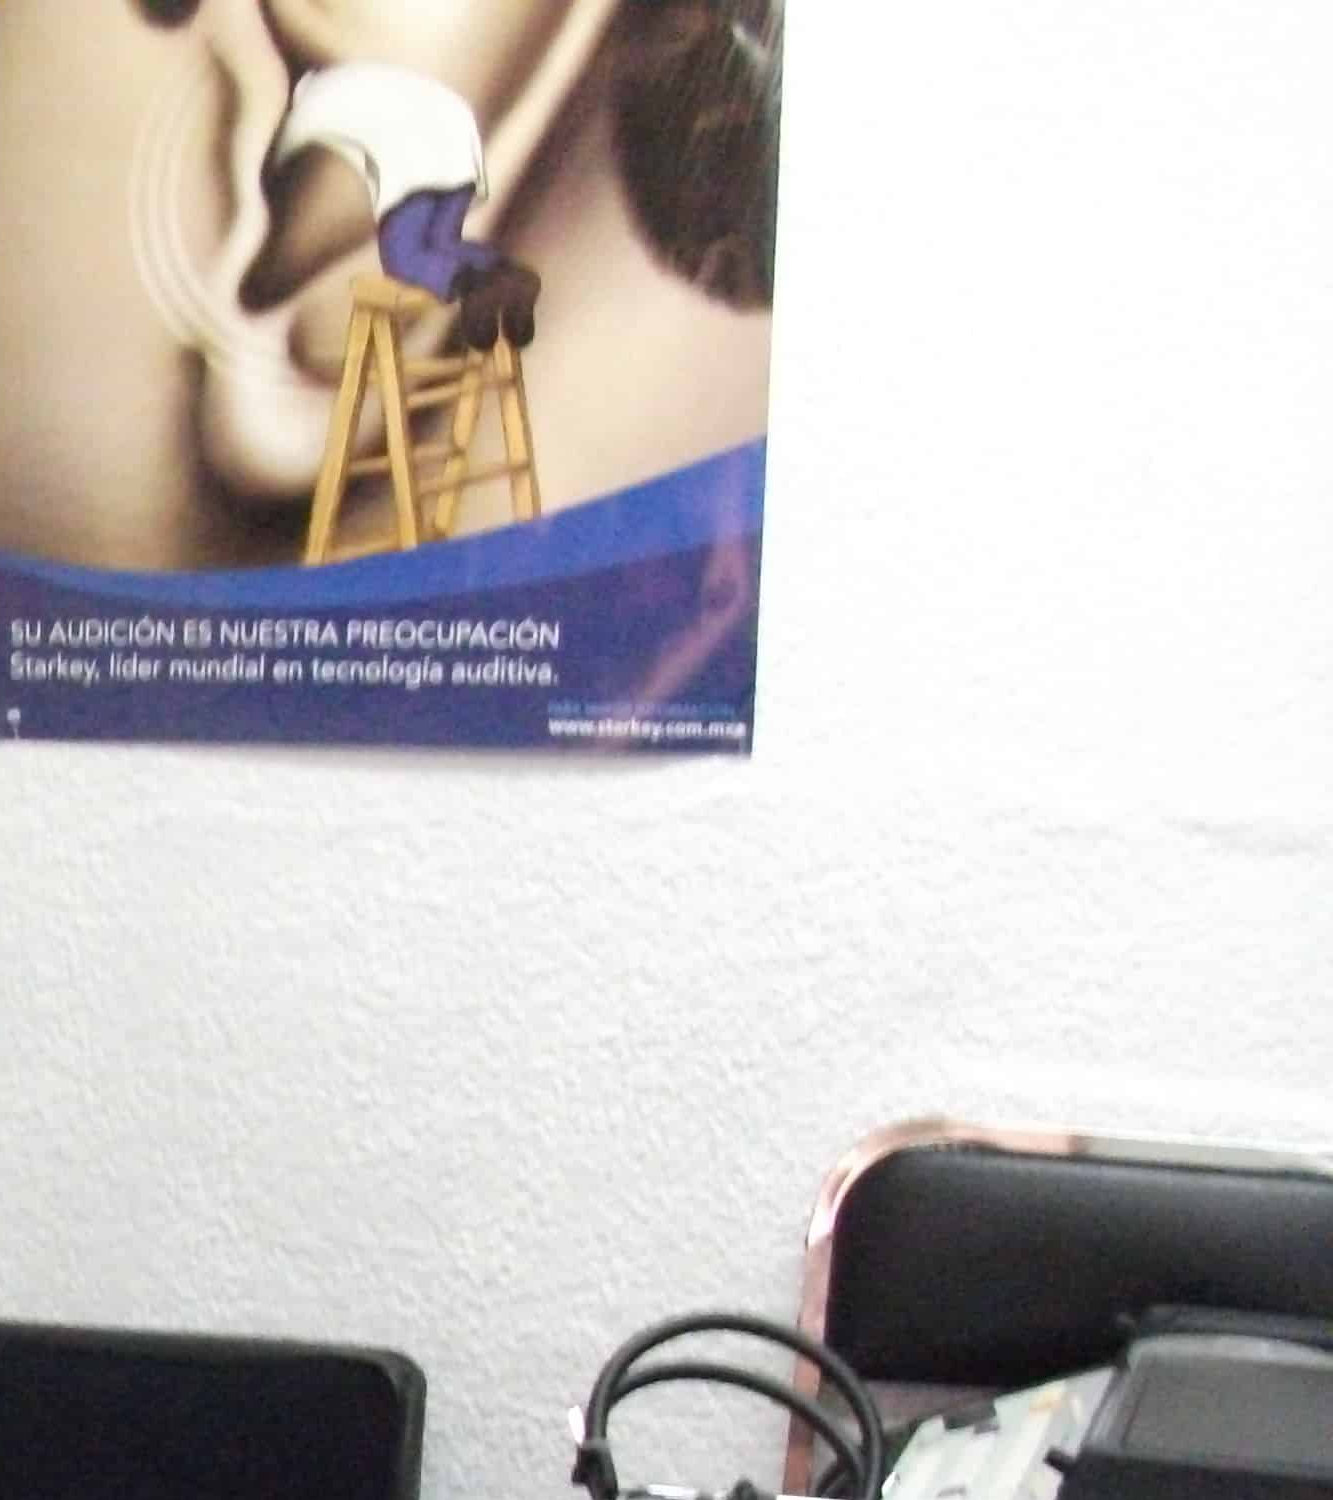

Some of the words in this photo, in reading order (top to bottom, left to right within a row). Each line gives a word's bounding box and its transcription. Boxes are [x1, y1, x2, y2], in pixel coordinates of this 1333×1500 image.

[10, 617, 42, 648] SU
[48, 613, 176, 648] AUDICIÓN
[183, 617, 212, 648] ES
[219, 617, 339, 648] NUESTRA
[346, 616, 560, 649] PREOCUPACIÓN
[10, 651, 100, 687] Starkey,
[169, 652, 266, 683] mundial
[272, 659, 303, 683] en
[312, 655, 444, 690] tecnología
[451, 656, 560, 687] auditiva.
